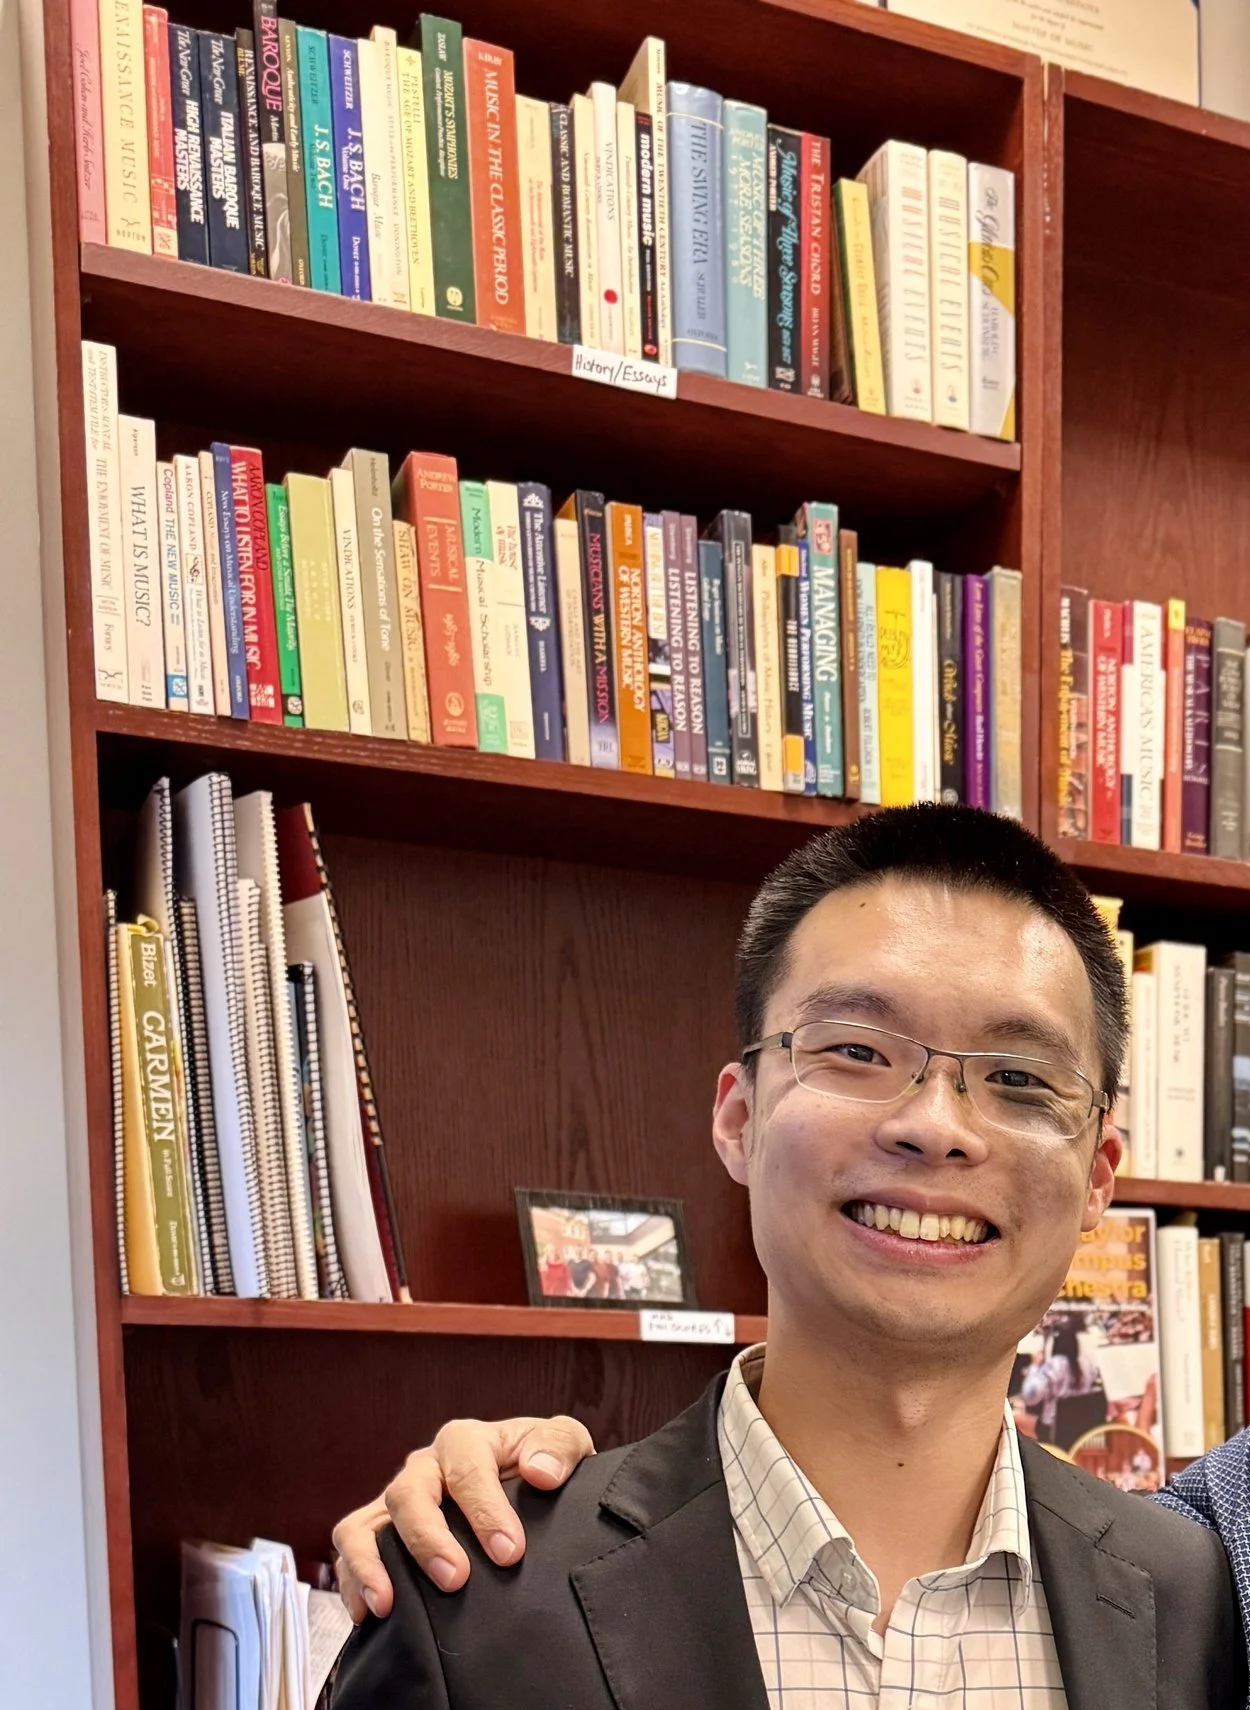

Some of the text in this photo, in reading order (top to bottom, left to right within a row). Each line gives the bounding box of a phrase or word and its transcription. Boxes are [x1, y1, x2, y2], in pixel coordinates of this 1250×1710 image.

[114, 0, 138, 203] ENAISSANCE MUSIC
[177, 30, 192, 95] The New Grove
[212, 39, 226, 104] The New Grove
[261, 16, 282, 110] BAROQUE
[343, 49, 354, 109] SCHWEITZER
[174, 128, 190, 191] MASTERS
[186, 100, 203, 224] HIGH RENAISSANCE
[209, 137, 224, 199] MASTERS
[220, 111, 239, 229] ITALIAN BAROQUE
[244, 49, 265, 250] RENAISSANCE AND BAROQUE MUSIC
[314, 124, 333, 209] J. S. BACH
[346, 127, 365, 211] J. S. BACH
[402, 71, 420, 264] THE AGE OF MOZART AND BEETHOVEN
[484, 68, 509, 304] MUSIC IN THE CLASSIC PERIOD
[605, 142, 615, 221] VINDICATIONS
[656, 120, 664, 133] OF
[657, 138, 665, 158] THE
[559, 114, 576, 277] CLASSIC AND ROMANTIC MUSIC
[640, 133, 654, 246] modern music
[658, 162, 666, 224] TWENTIETH
[690, 122, 709, 320] THE SWING ERA SCHULLER
[739, 156, 752, 287] MORE SEASONS
[752, 152, 765, 300] MUSIC OF THREE
[778, 142, 797, 328] Music of Three Seasons
[811, 140, 824, 295] THE TRISTAN CHORD
[658, 227, 667, 278] CENTURY
[130, 485, 151, 626] WHAT IS MUSIC?
[162, 468, 181, 610] Copland THE NEW MUSIC
[219, 490, 241, 654] New Essays on Musical Understanding
[231, 461, 260, 670] WHAT TO LISTEN FOR IN MUSIC
[249, 463, 269, 571] AARON COPLAND
[342, 529, 355, 610] VINDICATIONS
[426, 524, 441, 577] EVENTS
[444, 524, 458, 581] MUSICAL
[534, 512, 548, 614] The Attentive Listener
[371, 507, 391, 651] On the Sensations of Tone
[398, 529, 417, 652] SHAW ON MUSIC
[471, 506, 493, 687] Modern Musical Scholarship
[589, 533, 609, 725] MUSICIANS WITH A MISSION
[619, 565, 635, 692] OF WESTERN MUSIC
[813, 565, 837, 682] MANAGING
[1061, 597, 1070, 644] MACHLIS
[630, 567, 645, 713] NORTON ANTHOLOGY
[668, 568, 687, 732] LISTENING TO REASON
[685, 571, 704, 735] LISTENING TO REASON
[799, 581, 814, 740] WOMEN PERFORMING MUSIC
[1061, 651, 1071, 673] The
[1096, 656, 1106, 673] OF
[1061, 750, 1072, 764] of
[1096, 676, 1107, 725] WESTERN
[1106, 658, 1117, 790] NORTON ANTHOLOGY
[1140, 626, 1155, 800] AMERICA'S MUSIC
[142, 942, 160, 988] Bizet
[144, 1010, 175, 1144] CARMEN
